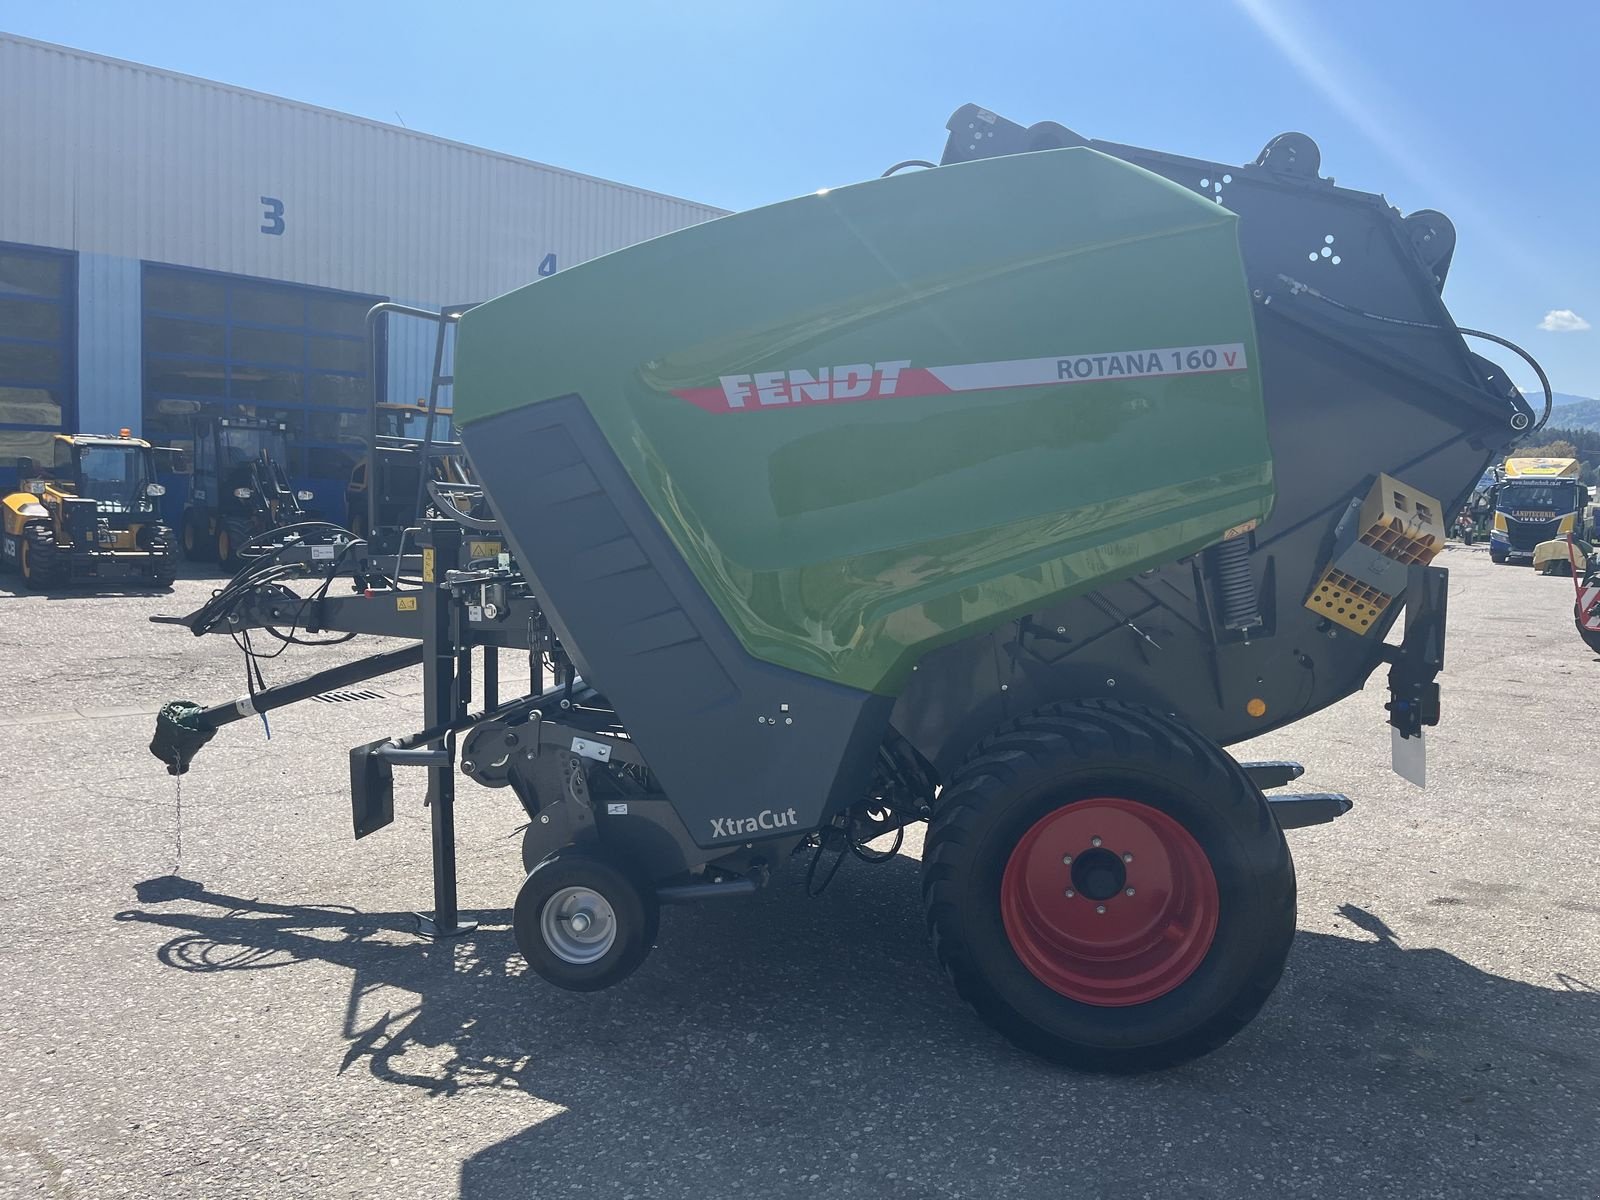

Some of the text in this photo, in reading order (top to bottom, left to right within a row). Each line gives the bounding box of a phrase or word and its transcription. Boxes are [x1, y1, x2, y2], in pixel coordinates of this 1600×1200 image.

[259, 196, 286, 236] 3
[538, 253, 557, 277] 4
[719, 360, 912, 408] FENDT
[1056, 352, 1164, 380] ROTANA
[1171, 348, 1218, 371] 160
[710, 807, 798, 838] XtraCut
